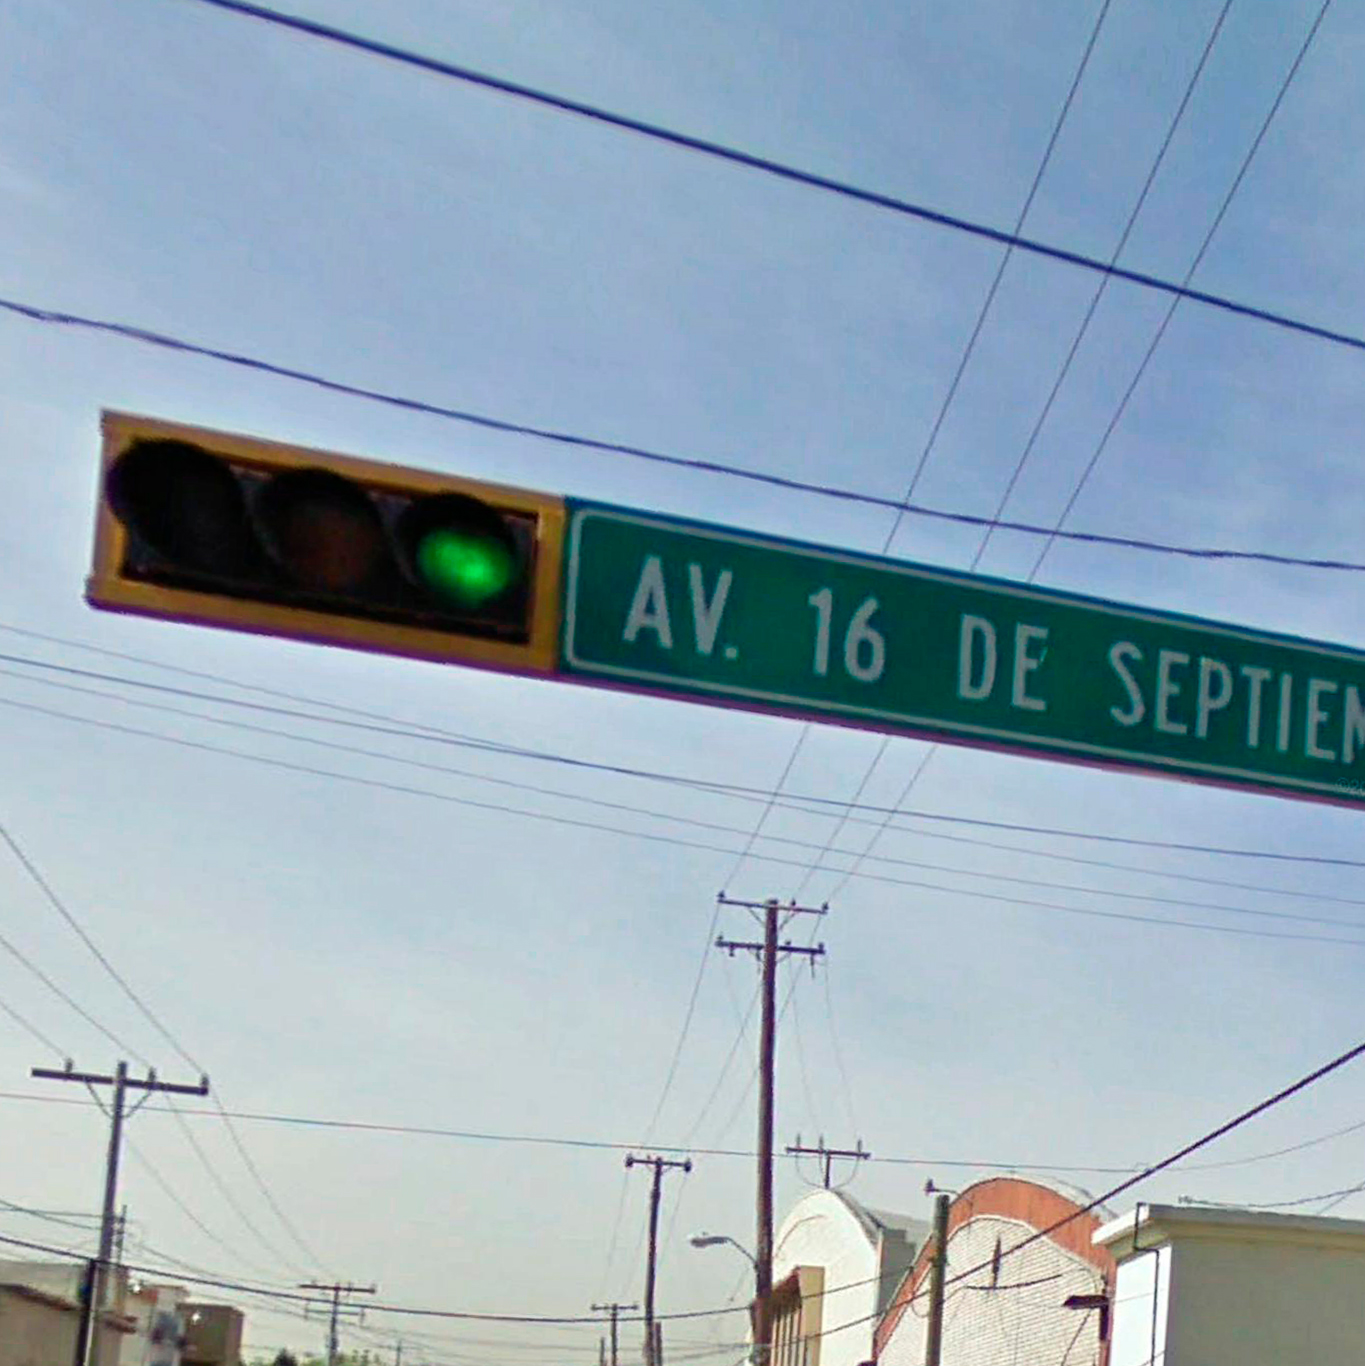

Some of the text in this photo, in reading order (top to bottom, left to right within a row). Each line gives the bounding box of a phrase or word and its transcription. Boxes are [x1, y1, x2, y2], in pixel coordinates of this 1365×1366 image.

[622, 555, 740, 661] AV.
[808, 587, 887, 684] 16
[955, 612, 1050, 712] DE
